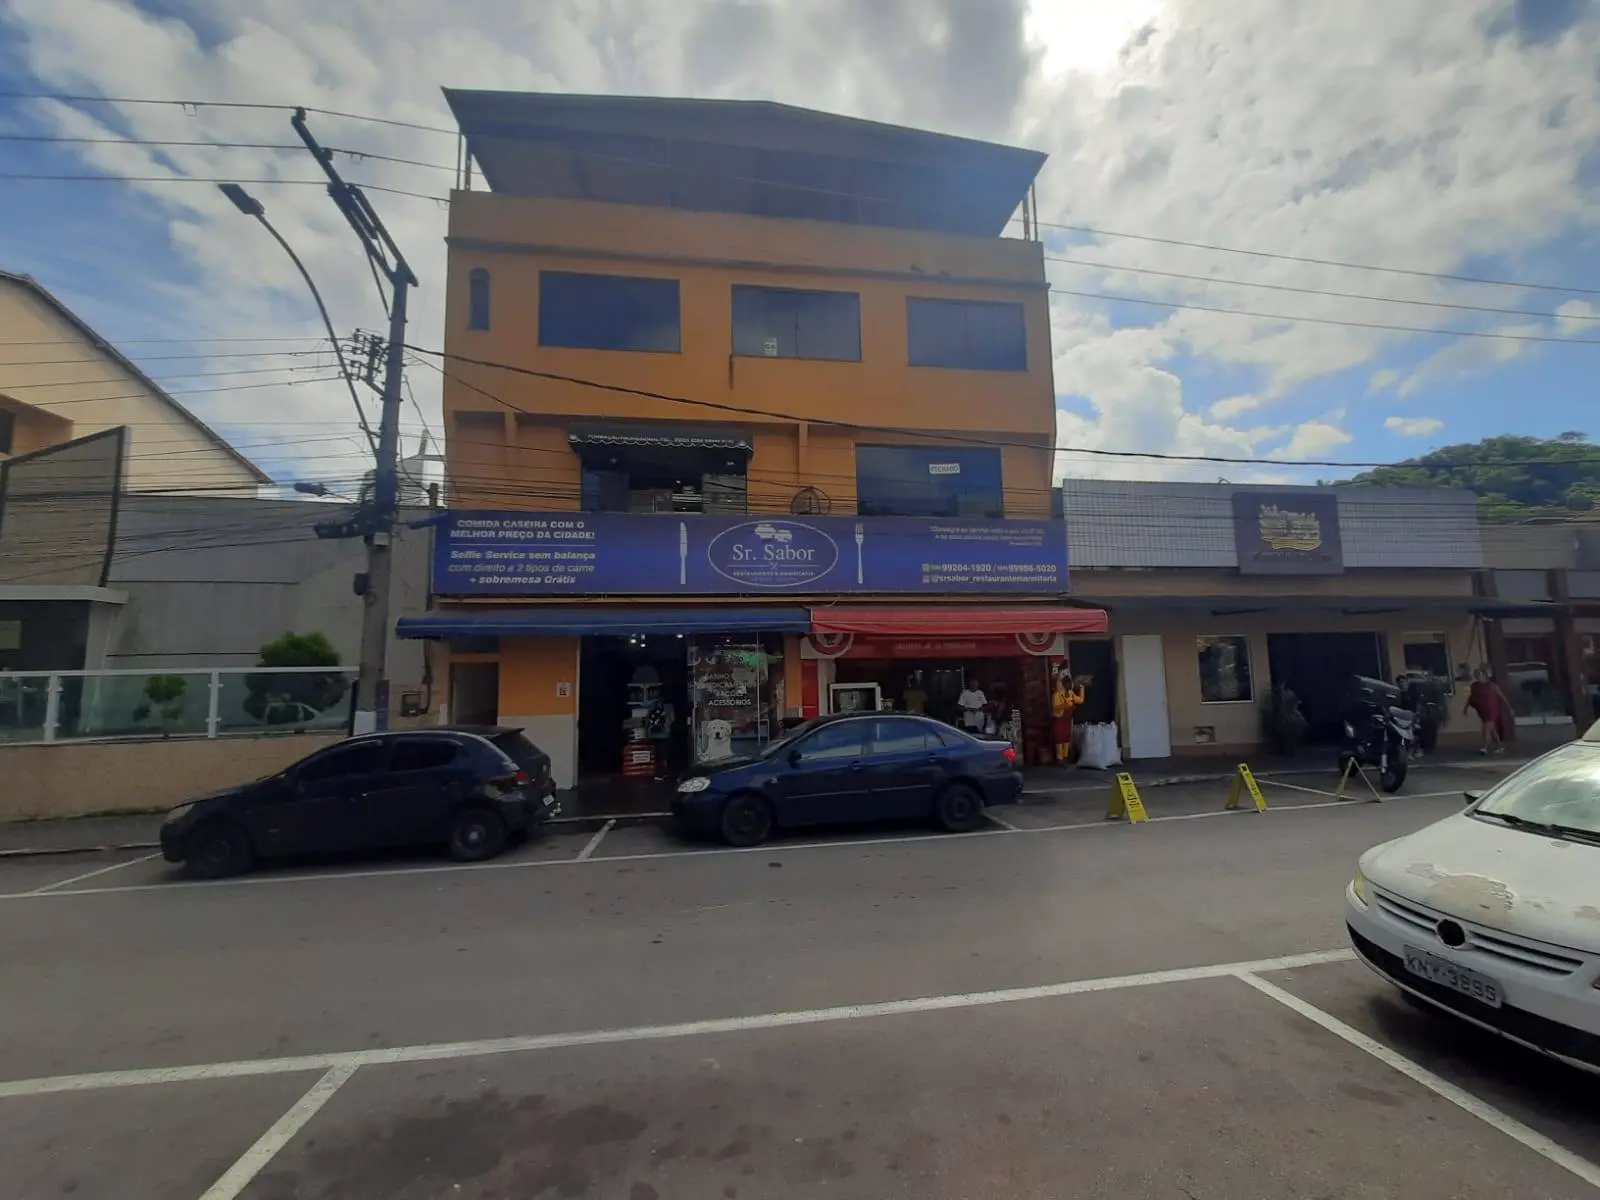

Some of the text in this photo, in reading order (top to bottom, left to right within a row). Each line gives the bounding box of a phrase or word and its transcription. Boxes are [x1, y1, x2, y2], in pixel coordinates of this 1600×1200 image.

[456, 519, 585, 529] COMIDA CASEIRA COM O
[450, 529, 595, 540] MELHOR PREÇO DA CIDADE!
[485, 550, 526, 560] Service
[528, 552, 551, 560] sem
[553, 551, 596, 561] balança
[732, 543, 816, 561] Sr. Sabor
[551, 563, 565, 572] de
[478, 575, 541, 584] sobremesa
